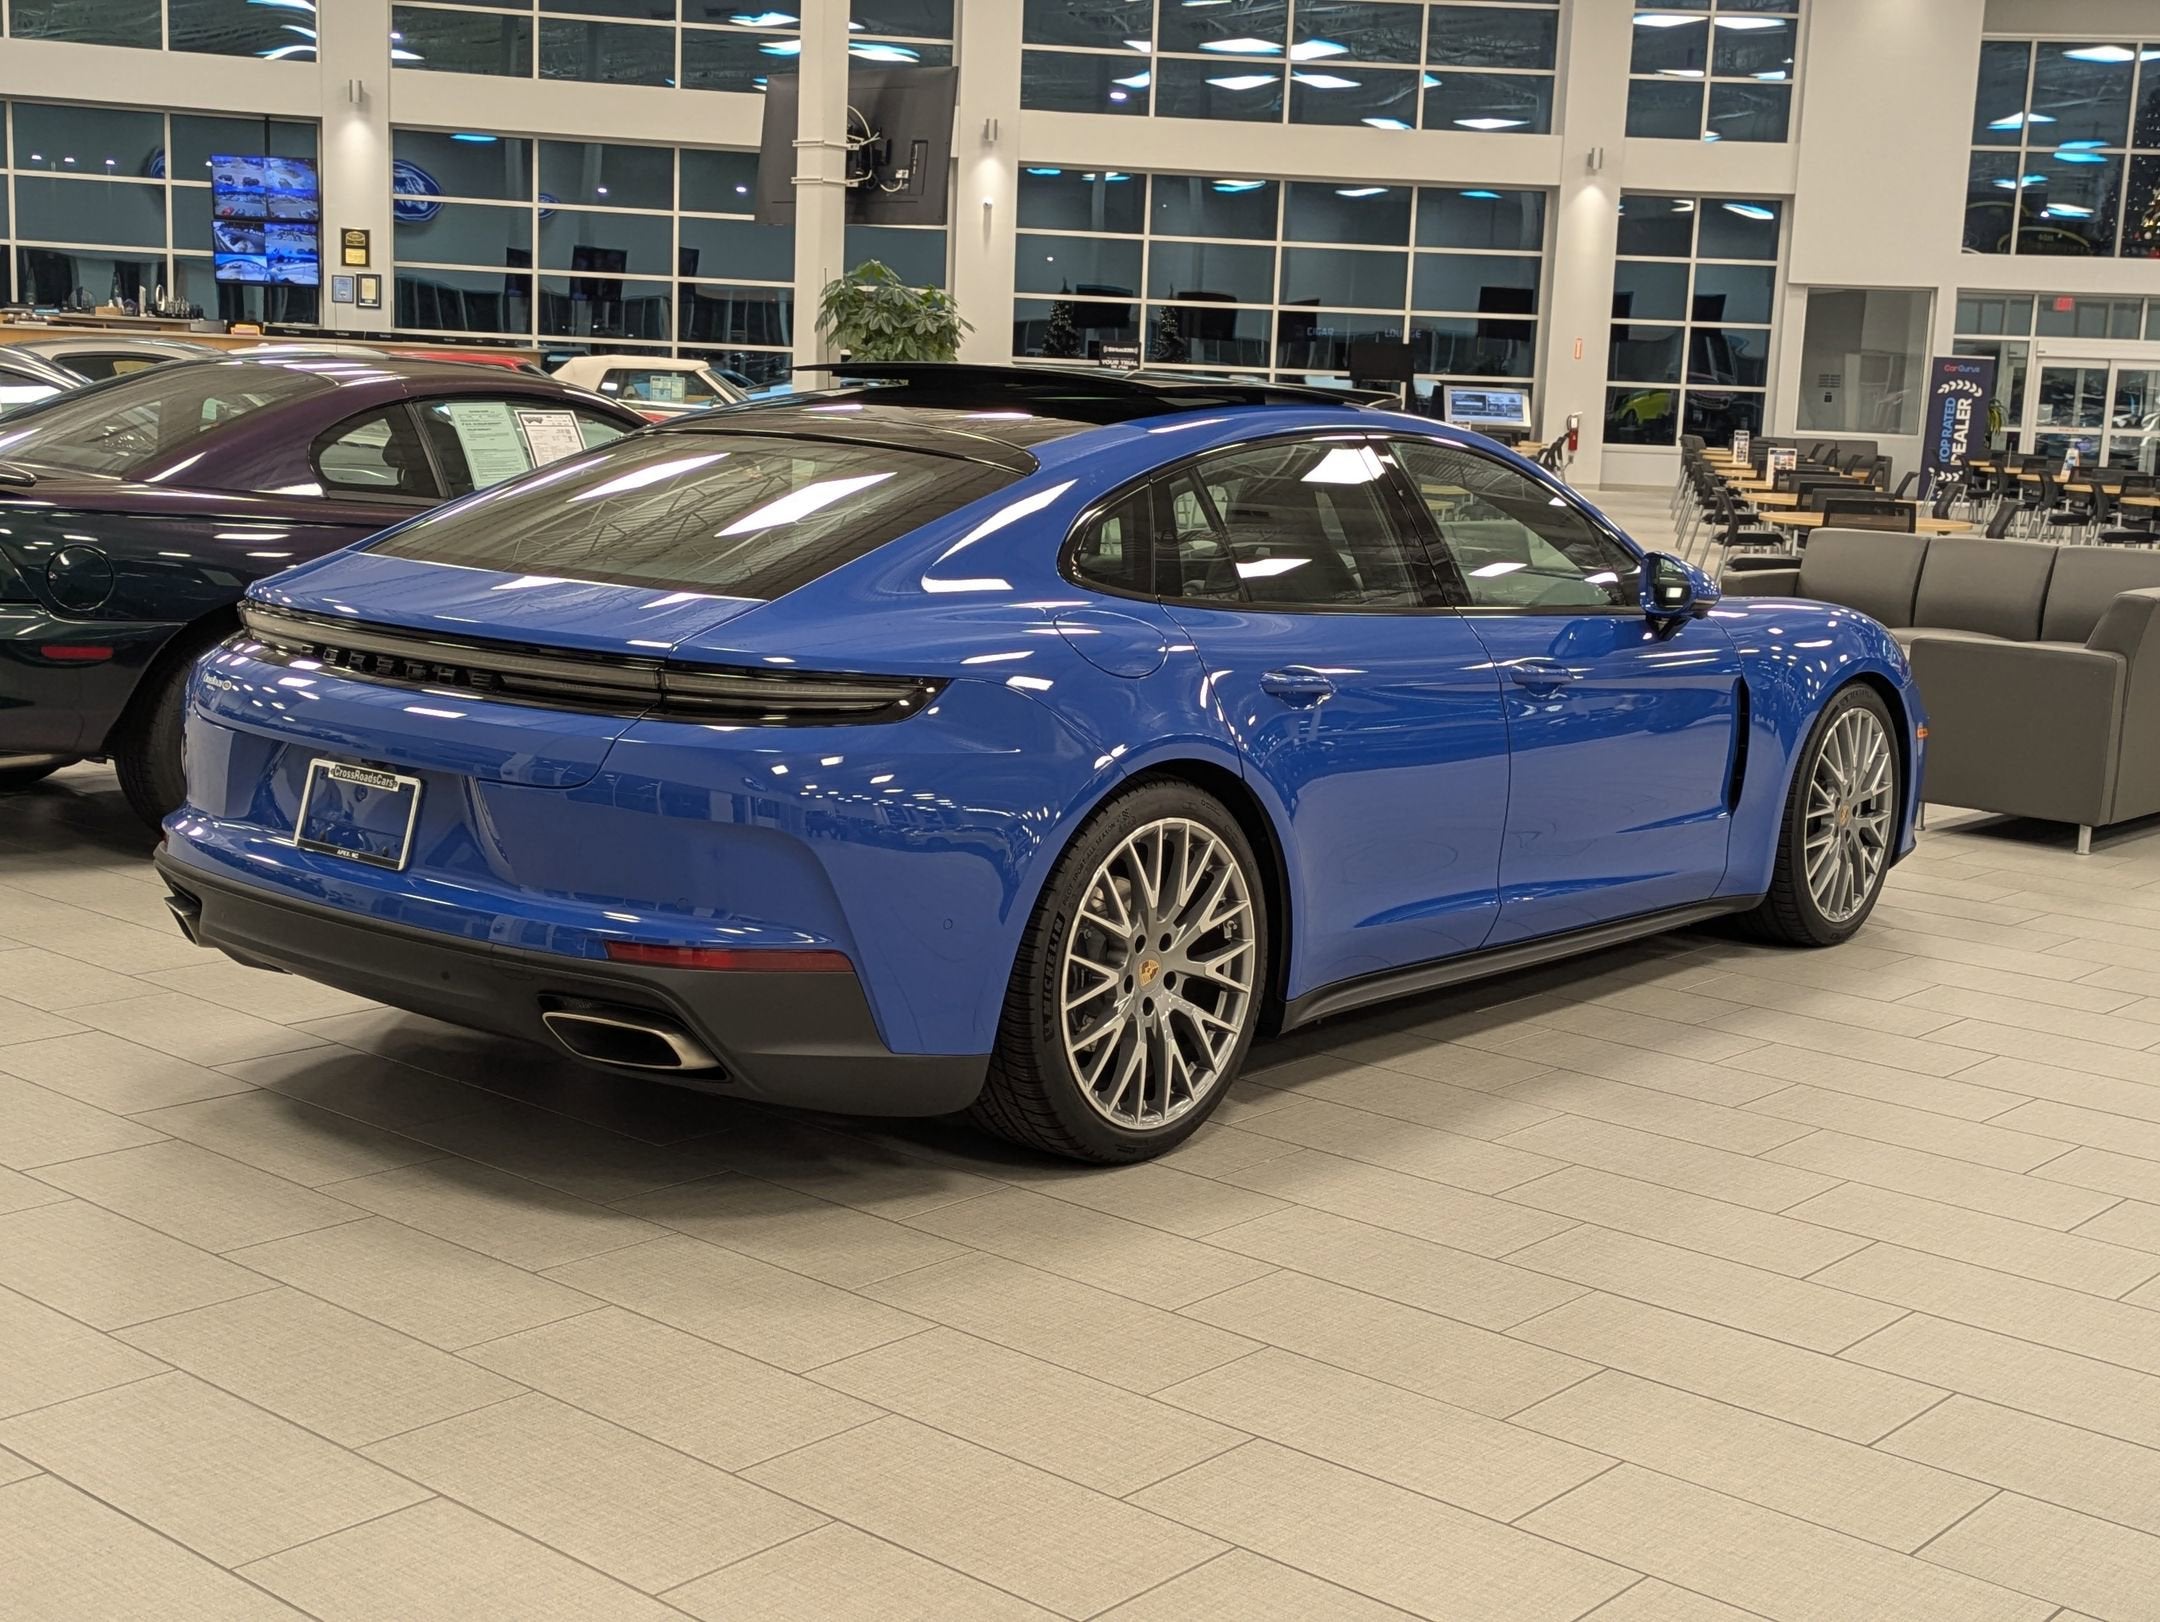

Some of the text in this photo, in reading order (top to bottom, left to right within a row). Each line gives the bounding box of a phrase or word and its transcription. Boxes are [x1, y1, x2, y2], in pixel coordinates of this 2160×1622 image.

[1939, 397, 1956, 463] TOP RATED
[1950, 398, 1972, 466] DEALER
[1043, 917, 1063, 1016] MICHELIN
